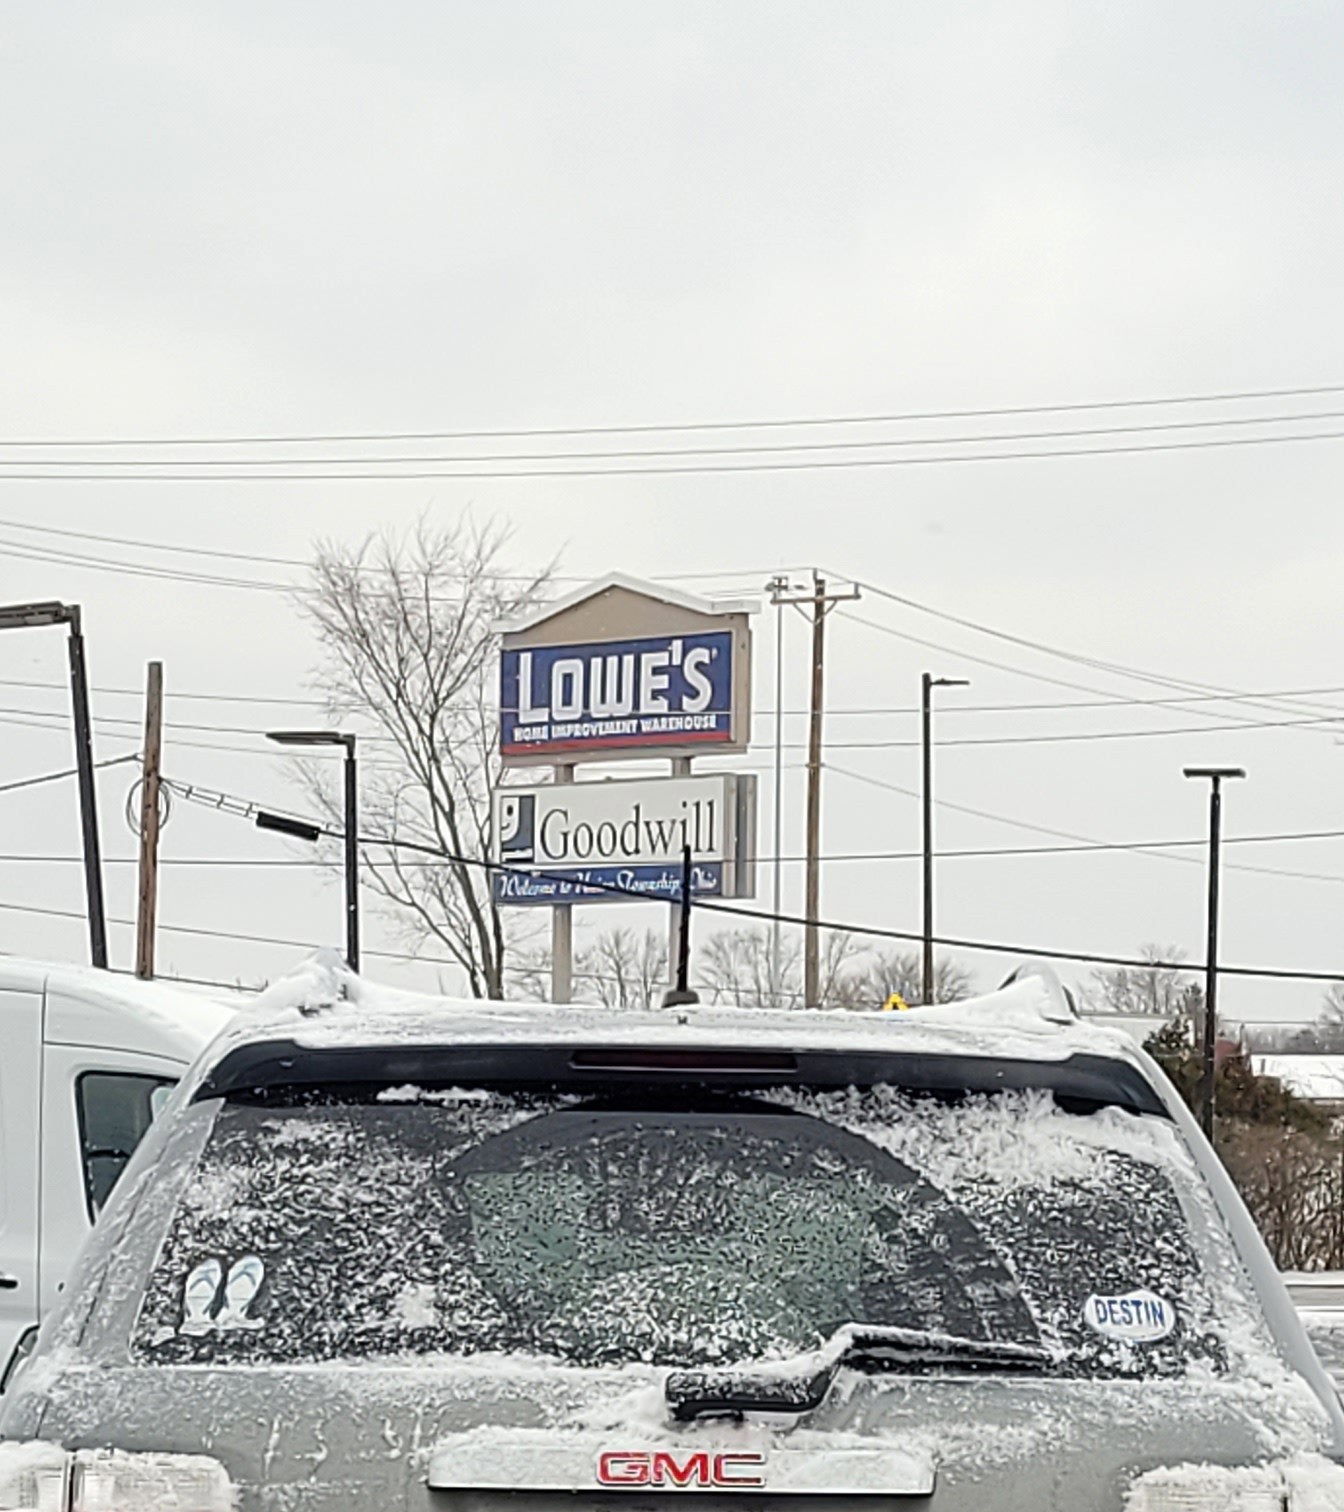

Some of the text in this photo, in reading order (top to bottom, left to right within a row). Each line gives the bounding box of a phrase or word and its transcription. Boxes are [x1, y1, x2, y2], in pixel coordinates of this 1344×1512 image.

[517, 640, 713, 724] LOWE'S
[513, 714, 717, 742] HOME IMPROVEMENT WAREHOUSE
[539, 799, 718, 861] Goodwill
[1093, 1298, 1166, 1329] DESTIN
[598, 1452, 766, 1487] GMC
